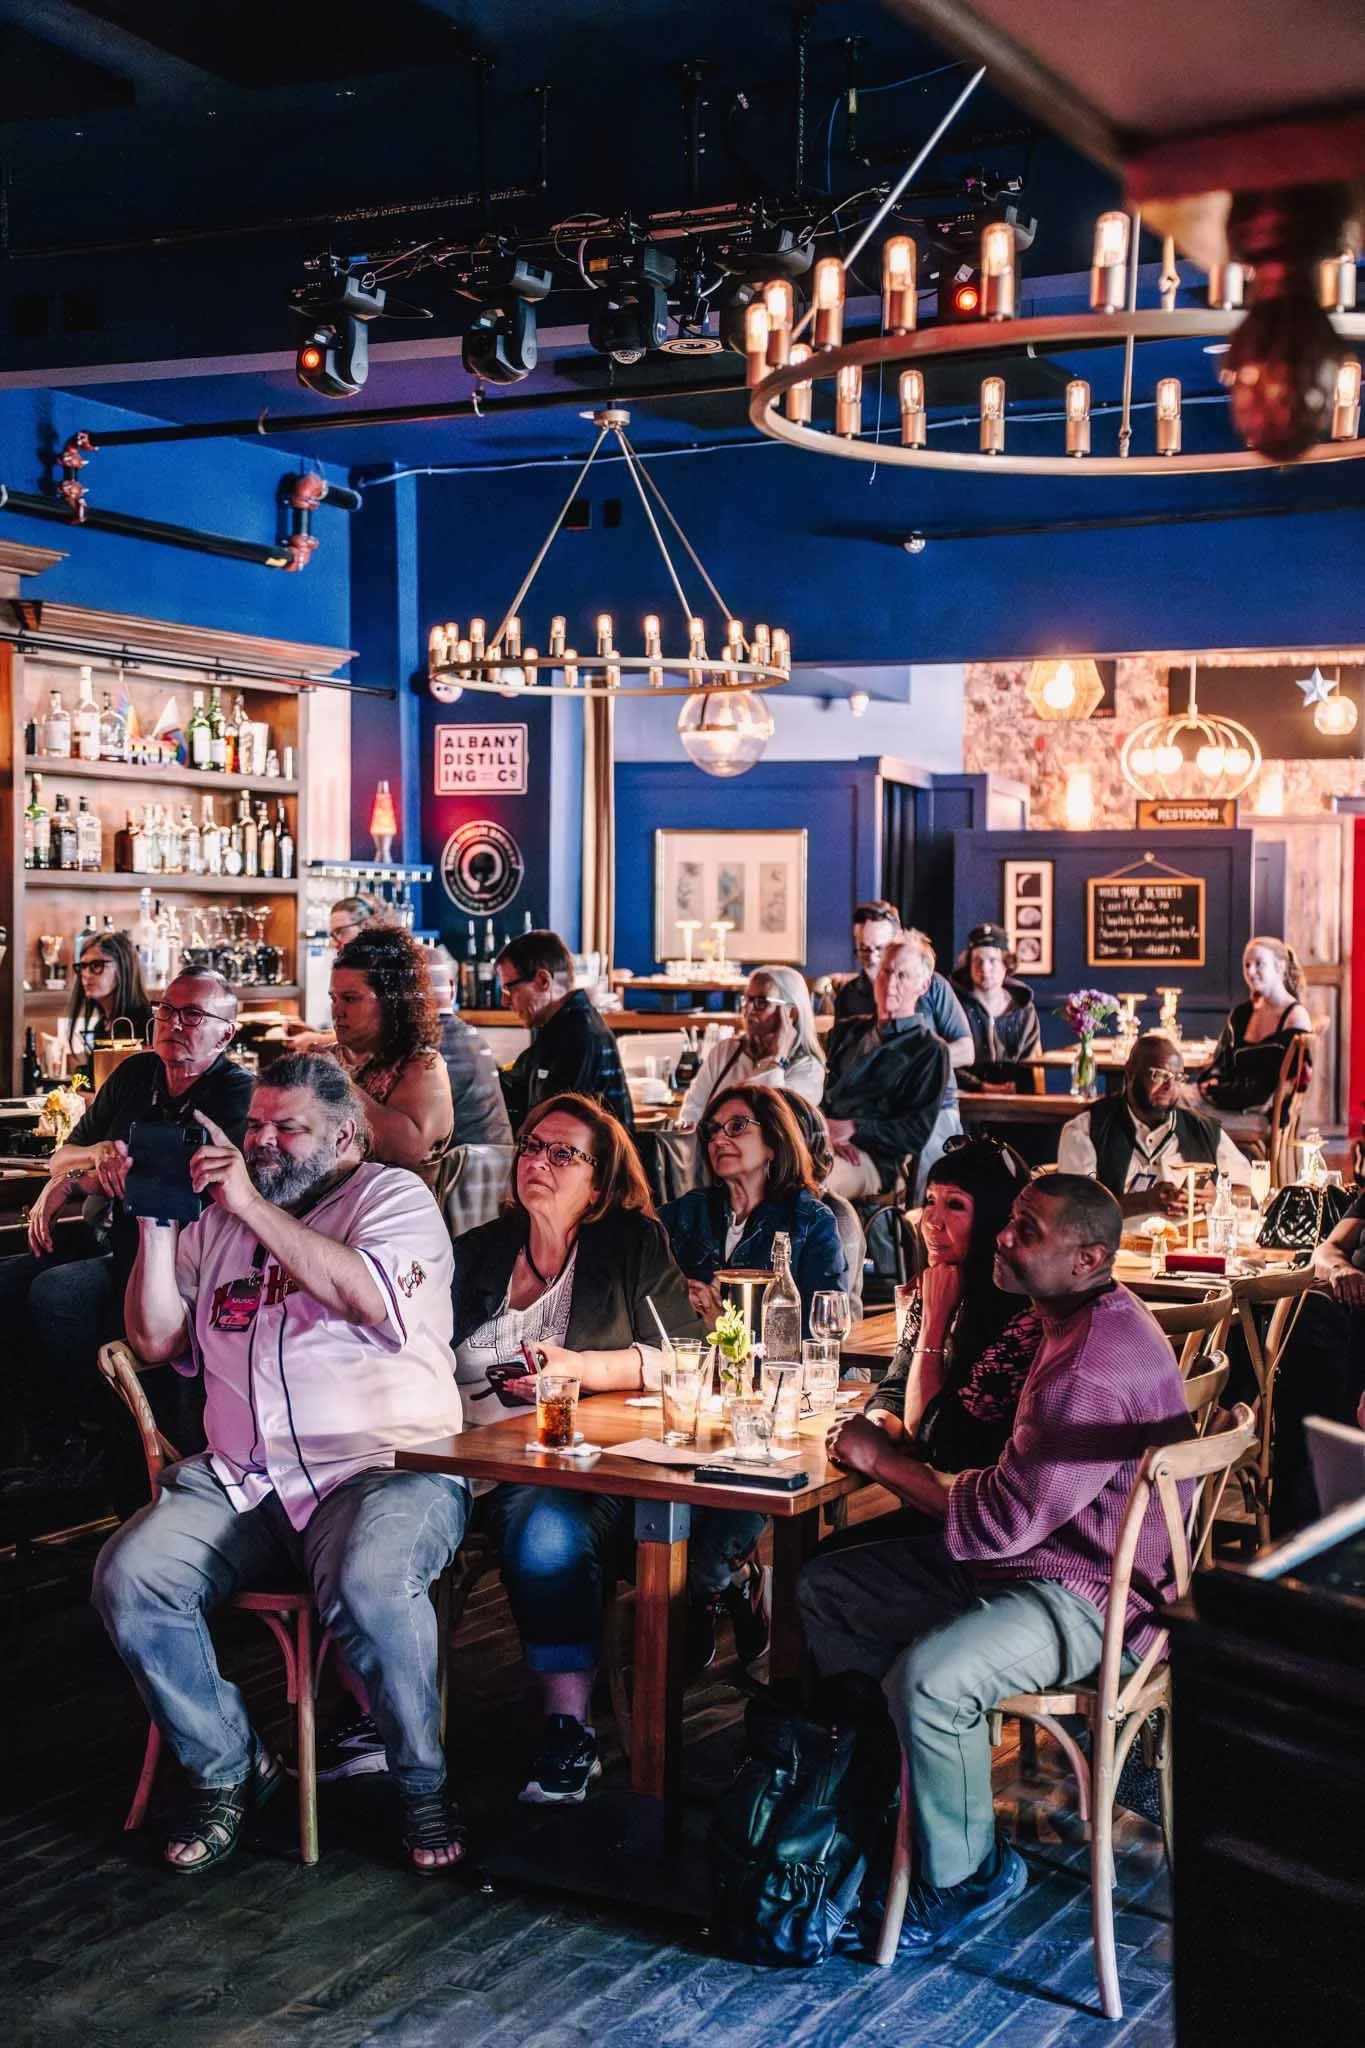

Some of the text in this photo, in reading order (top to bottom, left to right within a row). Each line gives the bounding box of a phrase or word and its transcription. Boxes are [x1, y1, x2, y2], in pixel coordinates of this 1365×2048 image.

[444, 735, 518, 749] ALBANY
[444, 752, 517, 766] DISTILL
[444, 770, 477, 782] ING
[1156, 807, 1218, 822] RESTROOM
